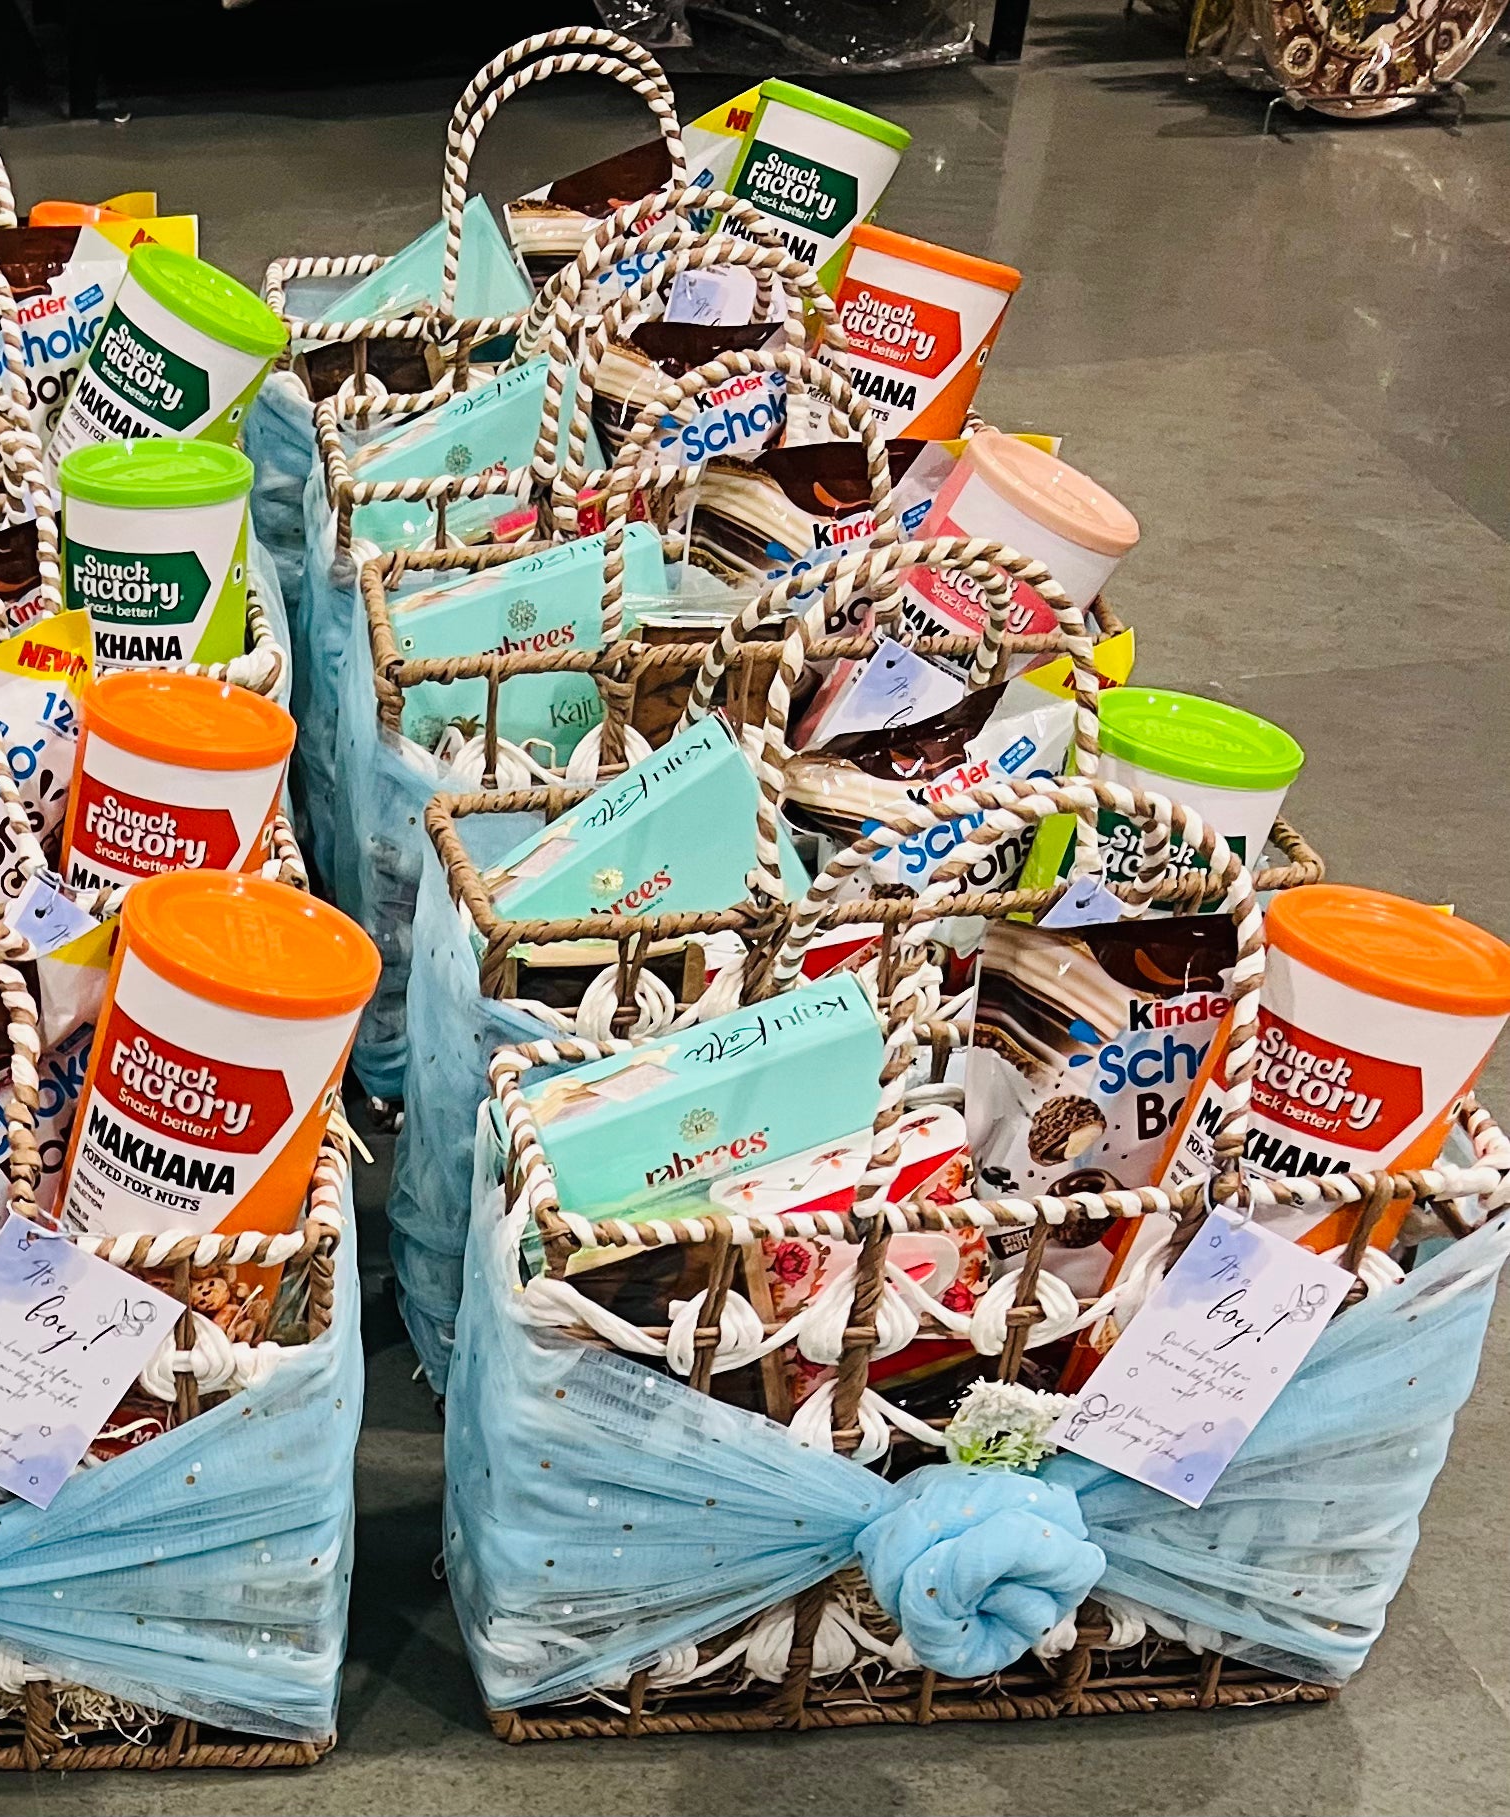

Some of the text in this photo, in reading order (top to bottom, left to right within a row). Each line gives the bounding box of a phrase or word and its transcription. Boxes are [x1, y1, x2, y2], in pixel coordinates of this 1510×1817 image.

[747, 161, 837, 221] Factory
[764, 153, 821, 190] Snack
[840, 300, 937, 361] Factory
[854, 291, 918, 328] Snack
[101, 328, 184, 411] Factory
[116, 324, 166, 376] Snack
[694, 374, 764, 413] Kinder
[73, 563, 179, 610] Factory
[84, 554, 150, 582] Snack
[116, 604, 159, 618] better!
[95, 632, 183, 662] KHANA
[41, 692, 74, 733] 12
[906, 760, 990, 806] Kinder
[86, 801, 207, 869] Factory
[102, 795, 177, 836] Snack
[94, 841, 131, 866] Snack
[1129, 995, 1231, 1032] Kinde
[128, 1036, 219, 1095] Snack
[1261, 1026, 1353, 1087] Snack
[110, 1042, 252, 1135] Factory
[119, 1088, 219, 1141] Snack better!
[1250, 1050, 1383, 1131] actory
[1283, 1098, 1342, 1134] better!
[89, 1105, 235, 1196] MAKHANA
[83, 1143, 122, 1183] POPPED
[123, 1174, 154, 1199] FOX
[155, 1189, 201, 1212] NUTS
[25, 1295, 117, 1354] boy!
[1206, 1289, 1290, 1351] boy!
